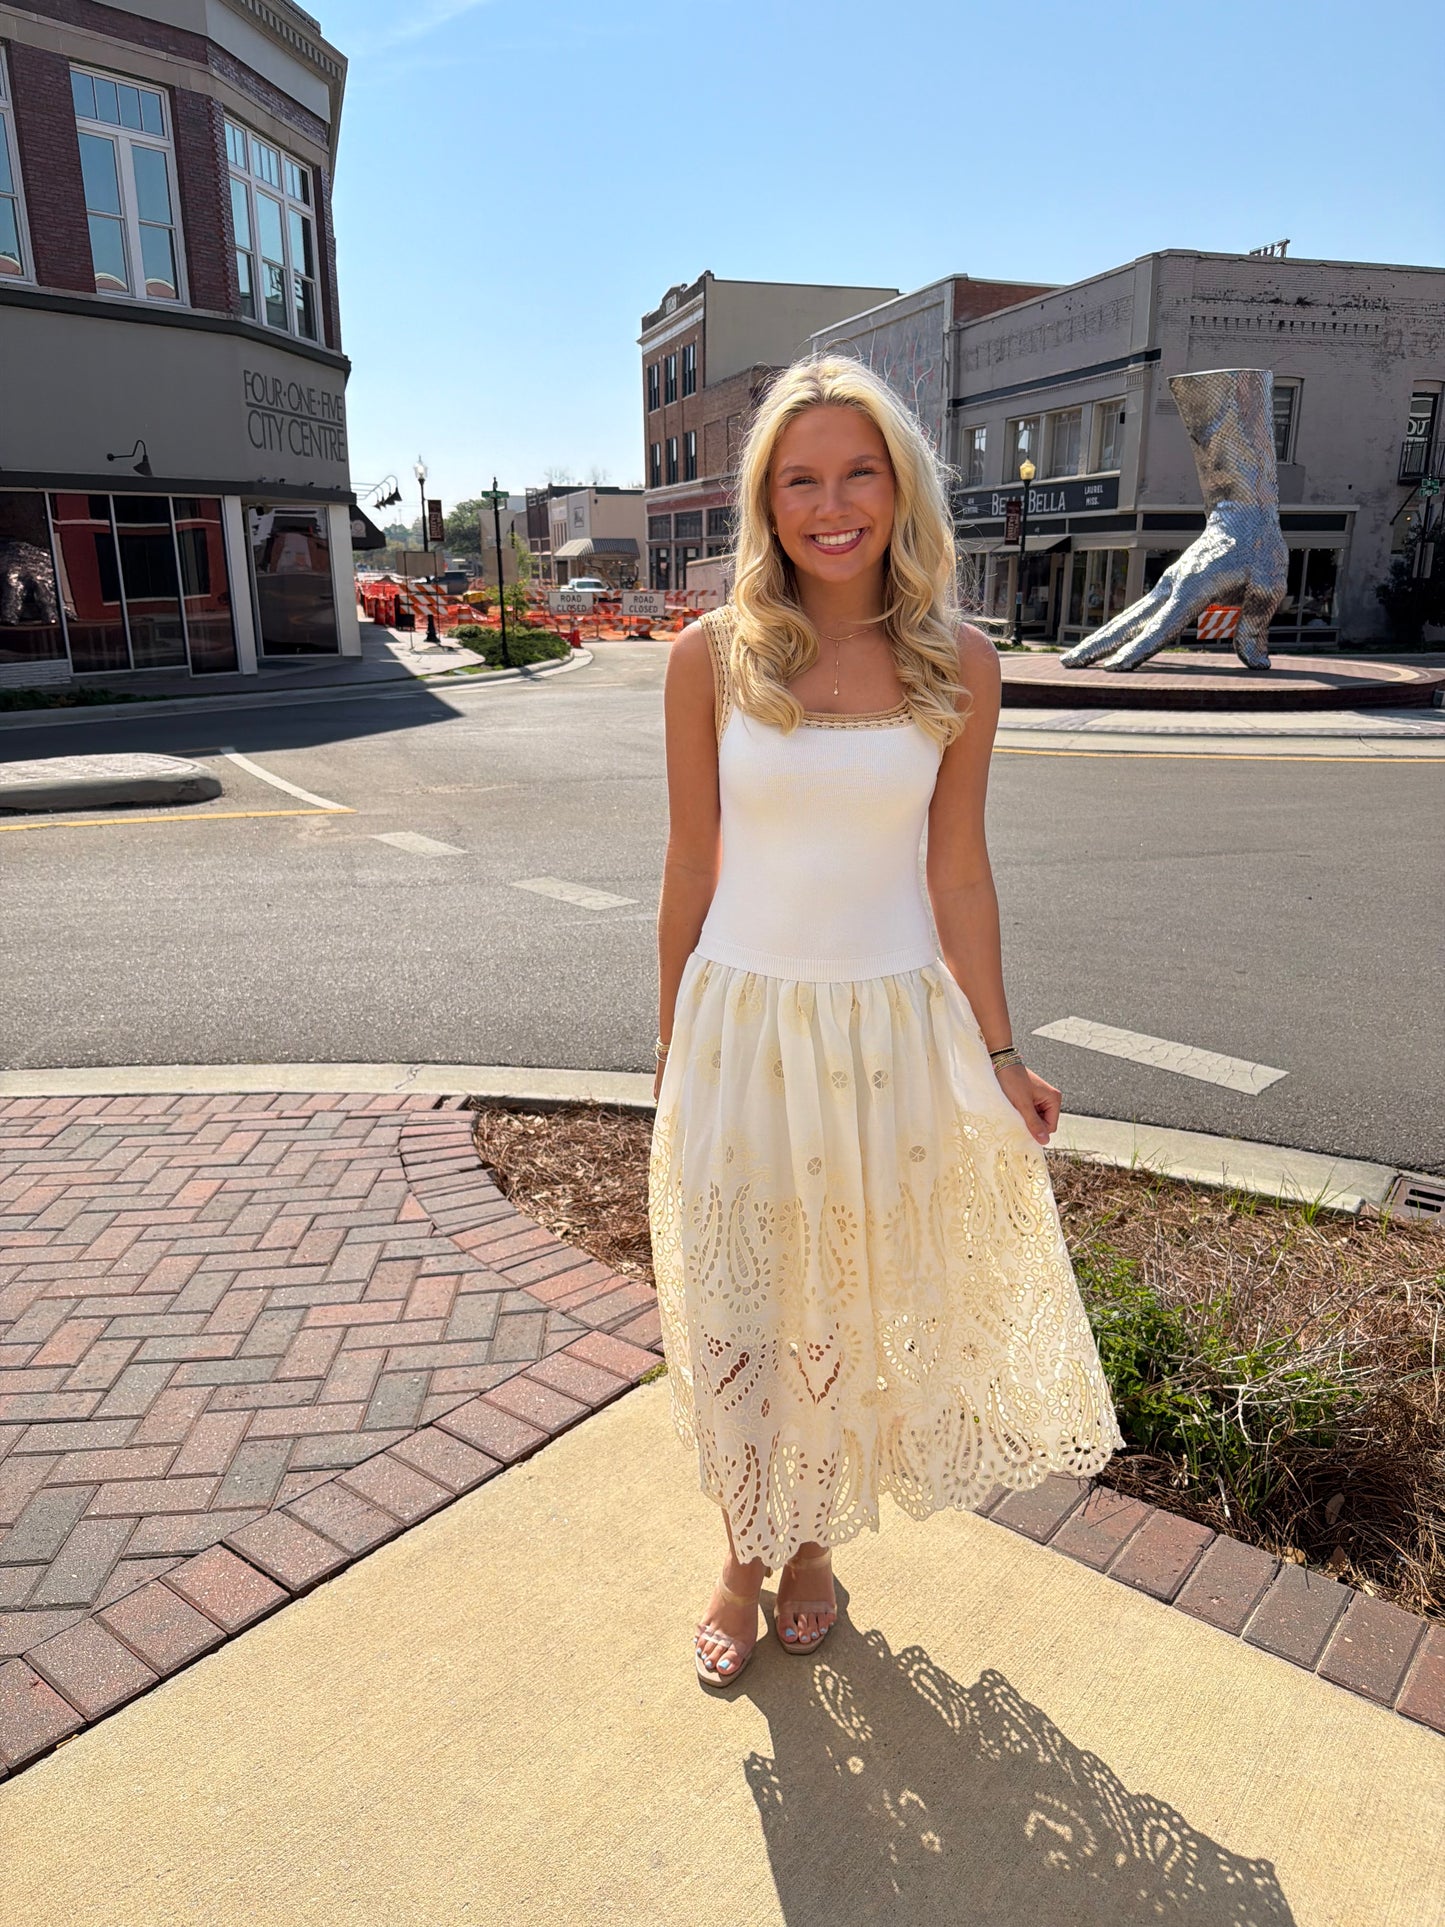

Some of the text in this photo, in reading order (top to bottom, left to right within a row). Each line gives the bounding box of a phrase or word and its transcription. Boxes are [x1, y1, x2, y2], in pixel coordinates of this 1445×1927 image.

[247, 409, 346, 462] CITY CENTRE
[1028, 489, 1066, 514] BELLA
[560, 594, 582, 603] ROAD
[633, 595, 654, 603] ROAD
[556, 604, 587, 612] CLOSED
[629, 605, 658, 613] CLOSED
